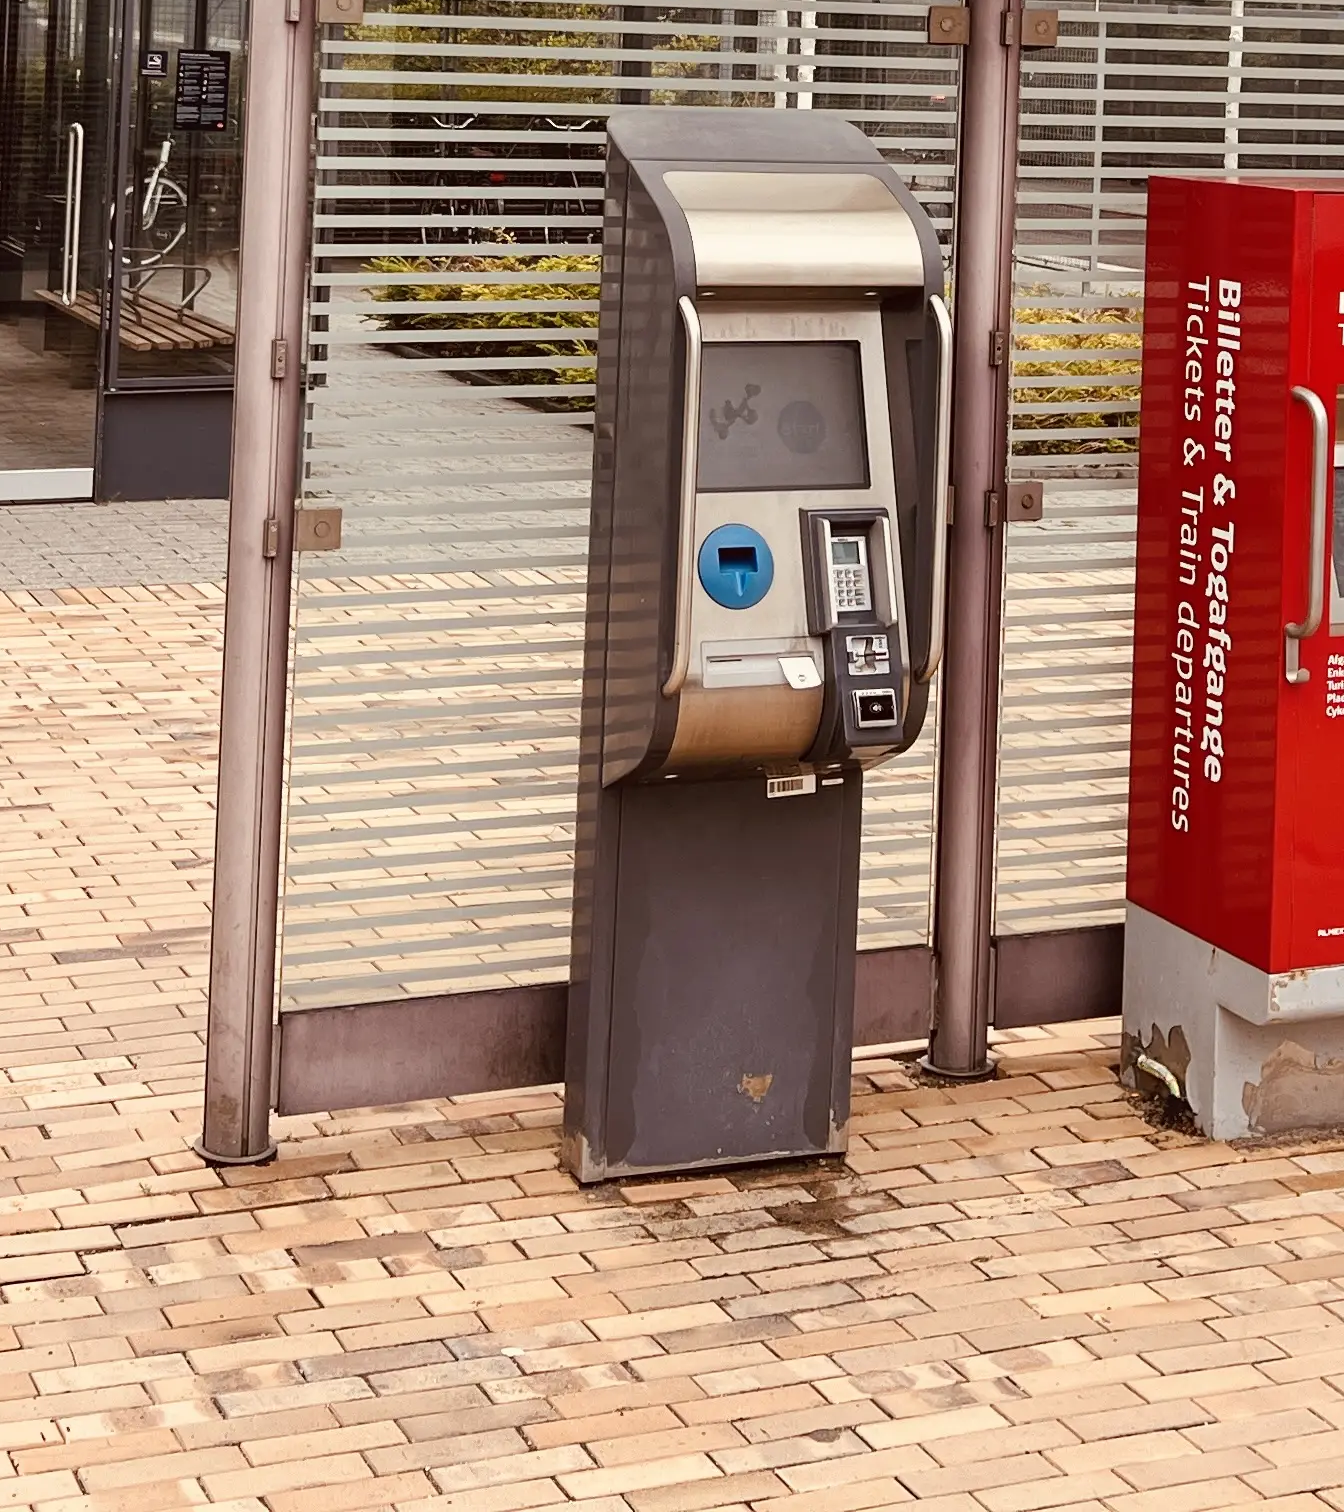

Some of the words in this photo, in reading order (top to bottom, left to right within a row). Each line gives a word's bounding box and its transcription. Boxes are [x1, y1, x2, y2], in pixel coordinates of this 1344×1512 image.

[1184, 275, 1210, 421] Tickets
[1213, 278, 1241, 462] Billetter
[1183, 438, 1205, 466] &
[1213, 473, 1236, 506] &
[1179, 486, 1204, 585] Train
[1171, 601, 1200, 832] departures
[1200, 521, 1235, 783] Togafgange
